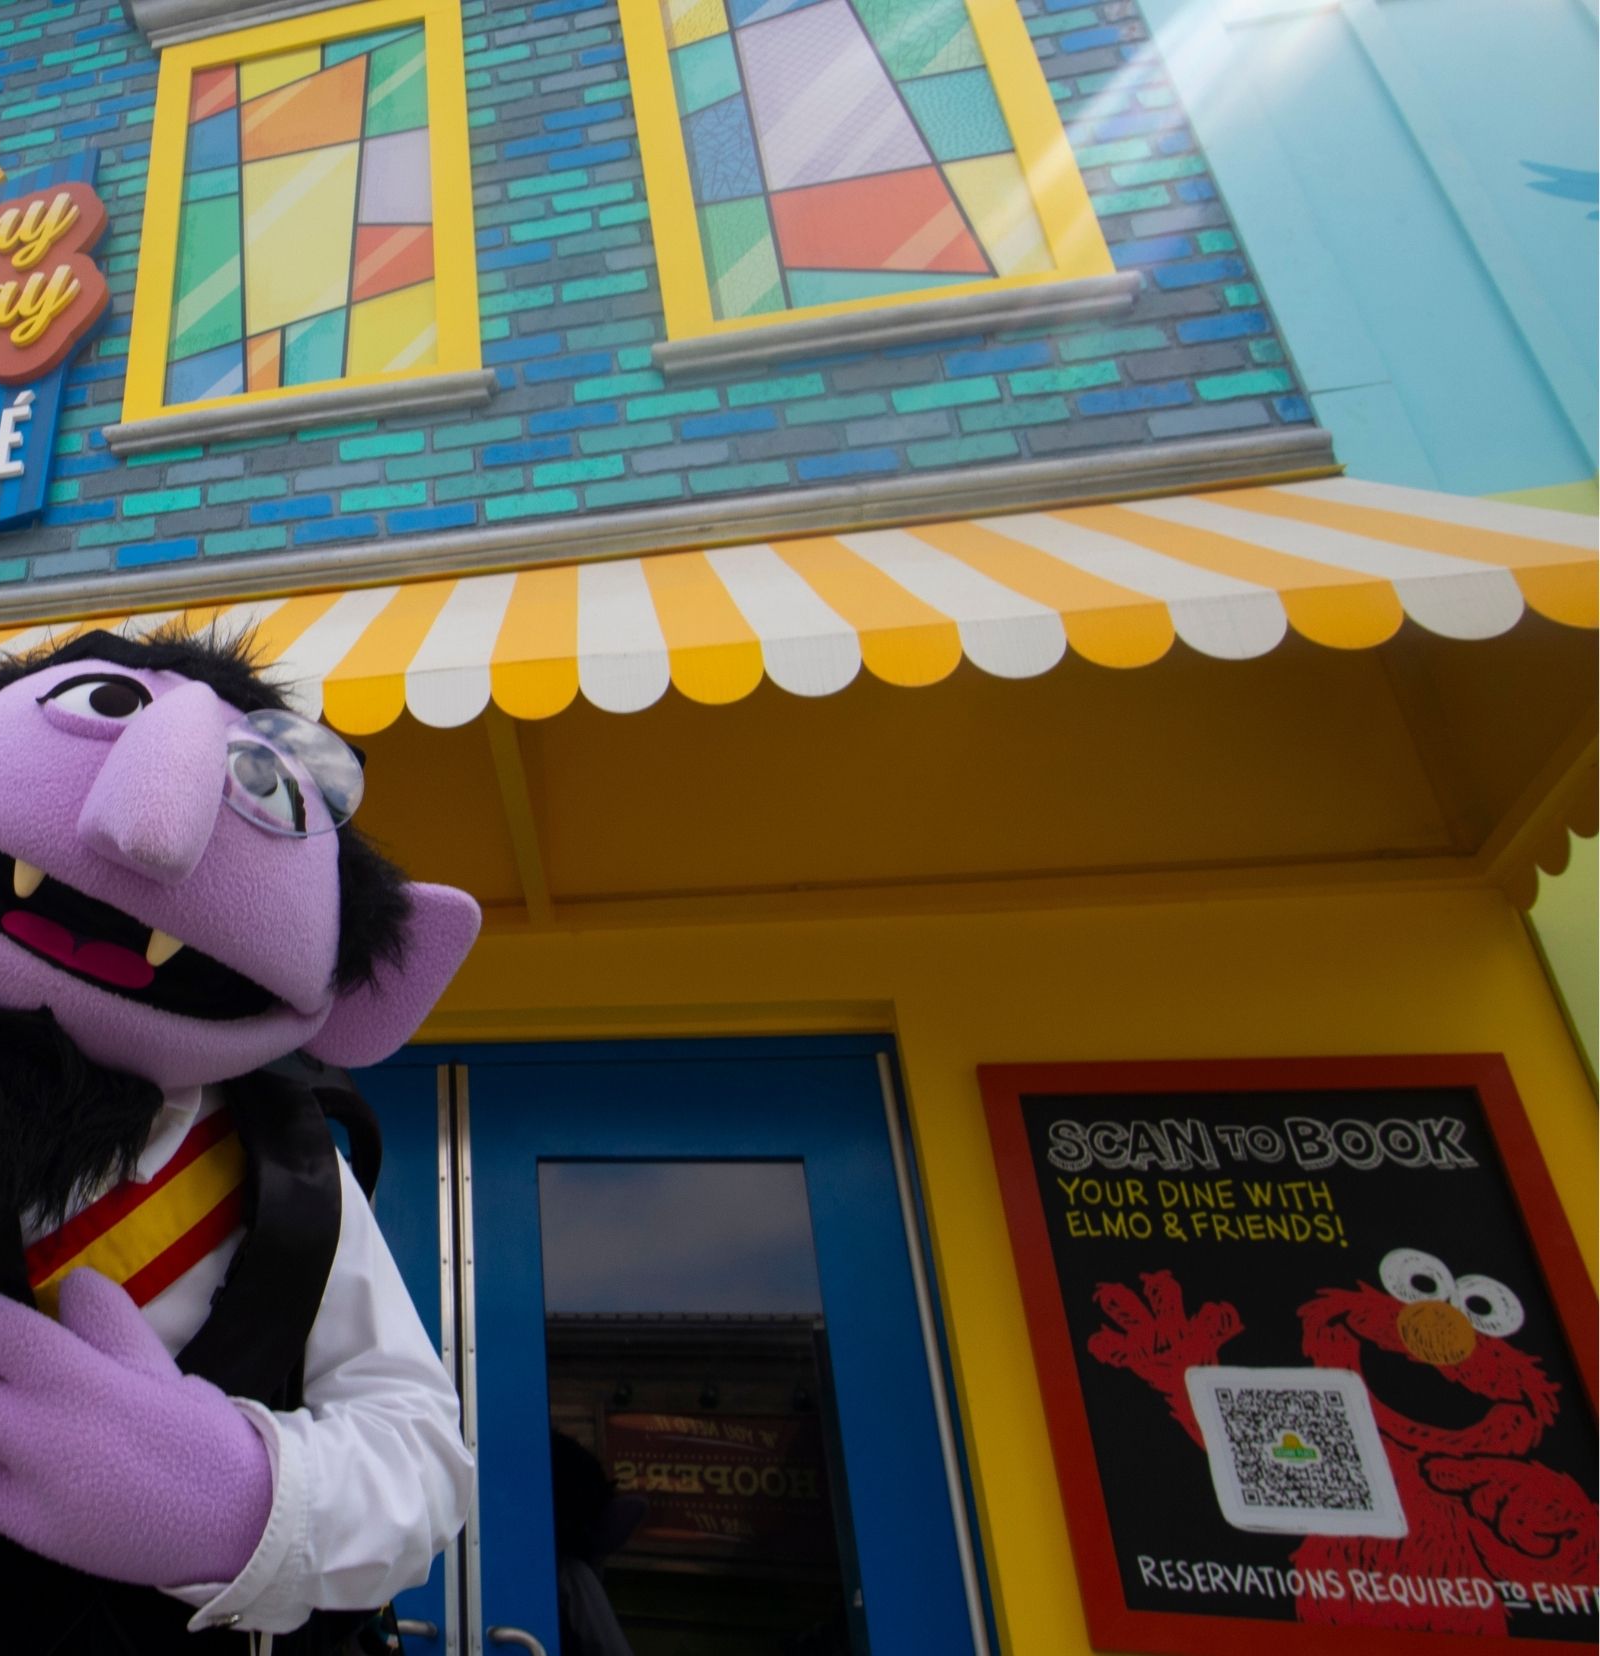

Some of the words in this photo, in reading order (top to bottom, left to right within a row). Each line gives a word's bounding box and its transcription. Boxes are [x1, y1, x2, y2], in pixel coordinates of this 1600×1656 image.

[1046, 1117, 1220, 1171] SCAN
[1216, 1124, 1286, 1162] TO
[1284, 1116, 1480, 1171] BOOK
[1057, 1176, 1149, 1207] YOUR
[1158, 1178, 1234, 1210] DINE
[1242, 1180, 1334, 1212] WITH
[1066, 1211, 1152, 1238] ELMO
[1163, 1212, 1188, 1242] &
[1192, 1211, 1349, 1248] FRIENDS!
[1137, 1555, 1345, 1599] RESERVATIONS
[1348, 1569, 1494, 1610] REQUIRED
[1493, 1581, 1532, 1603] TO
